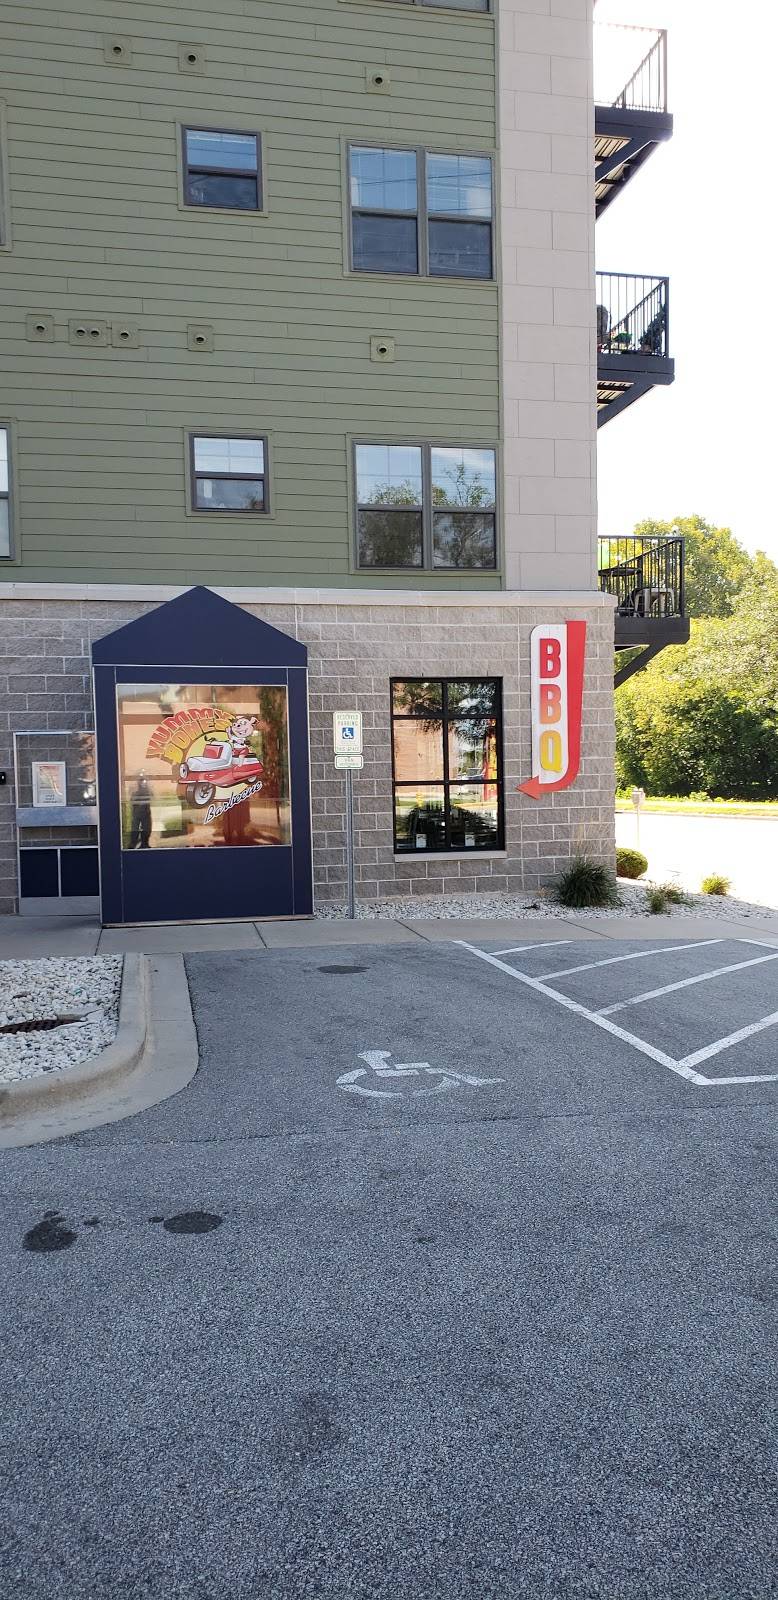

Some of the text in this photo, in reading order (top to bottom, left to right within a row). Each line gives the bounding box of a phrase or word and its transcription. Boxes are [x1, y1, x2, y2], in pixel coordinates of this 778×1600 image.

[539, 638, 562, 772] BBQ
[146, 708, 235, 758] YUMMY
[204, 781, 263, 824] Barbecue
